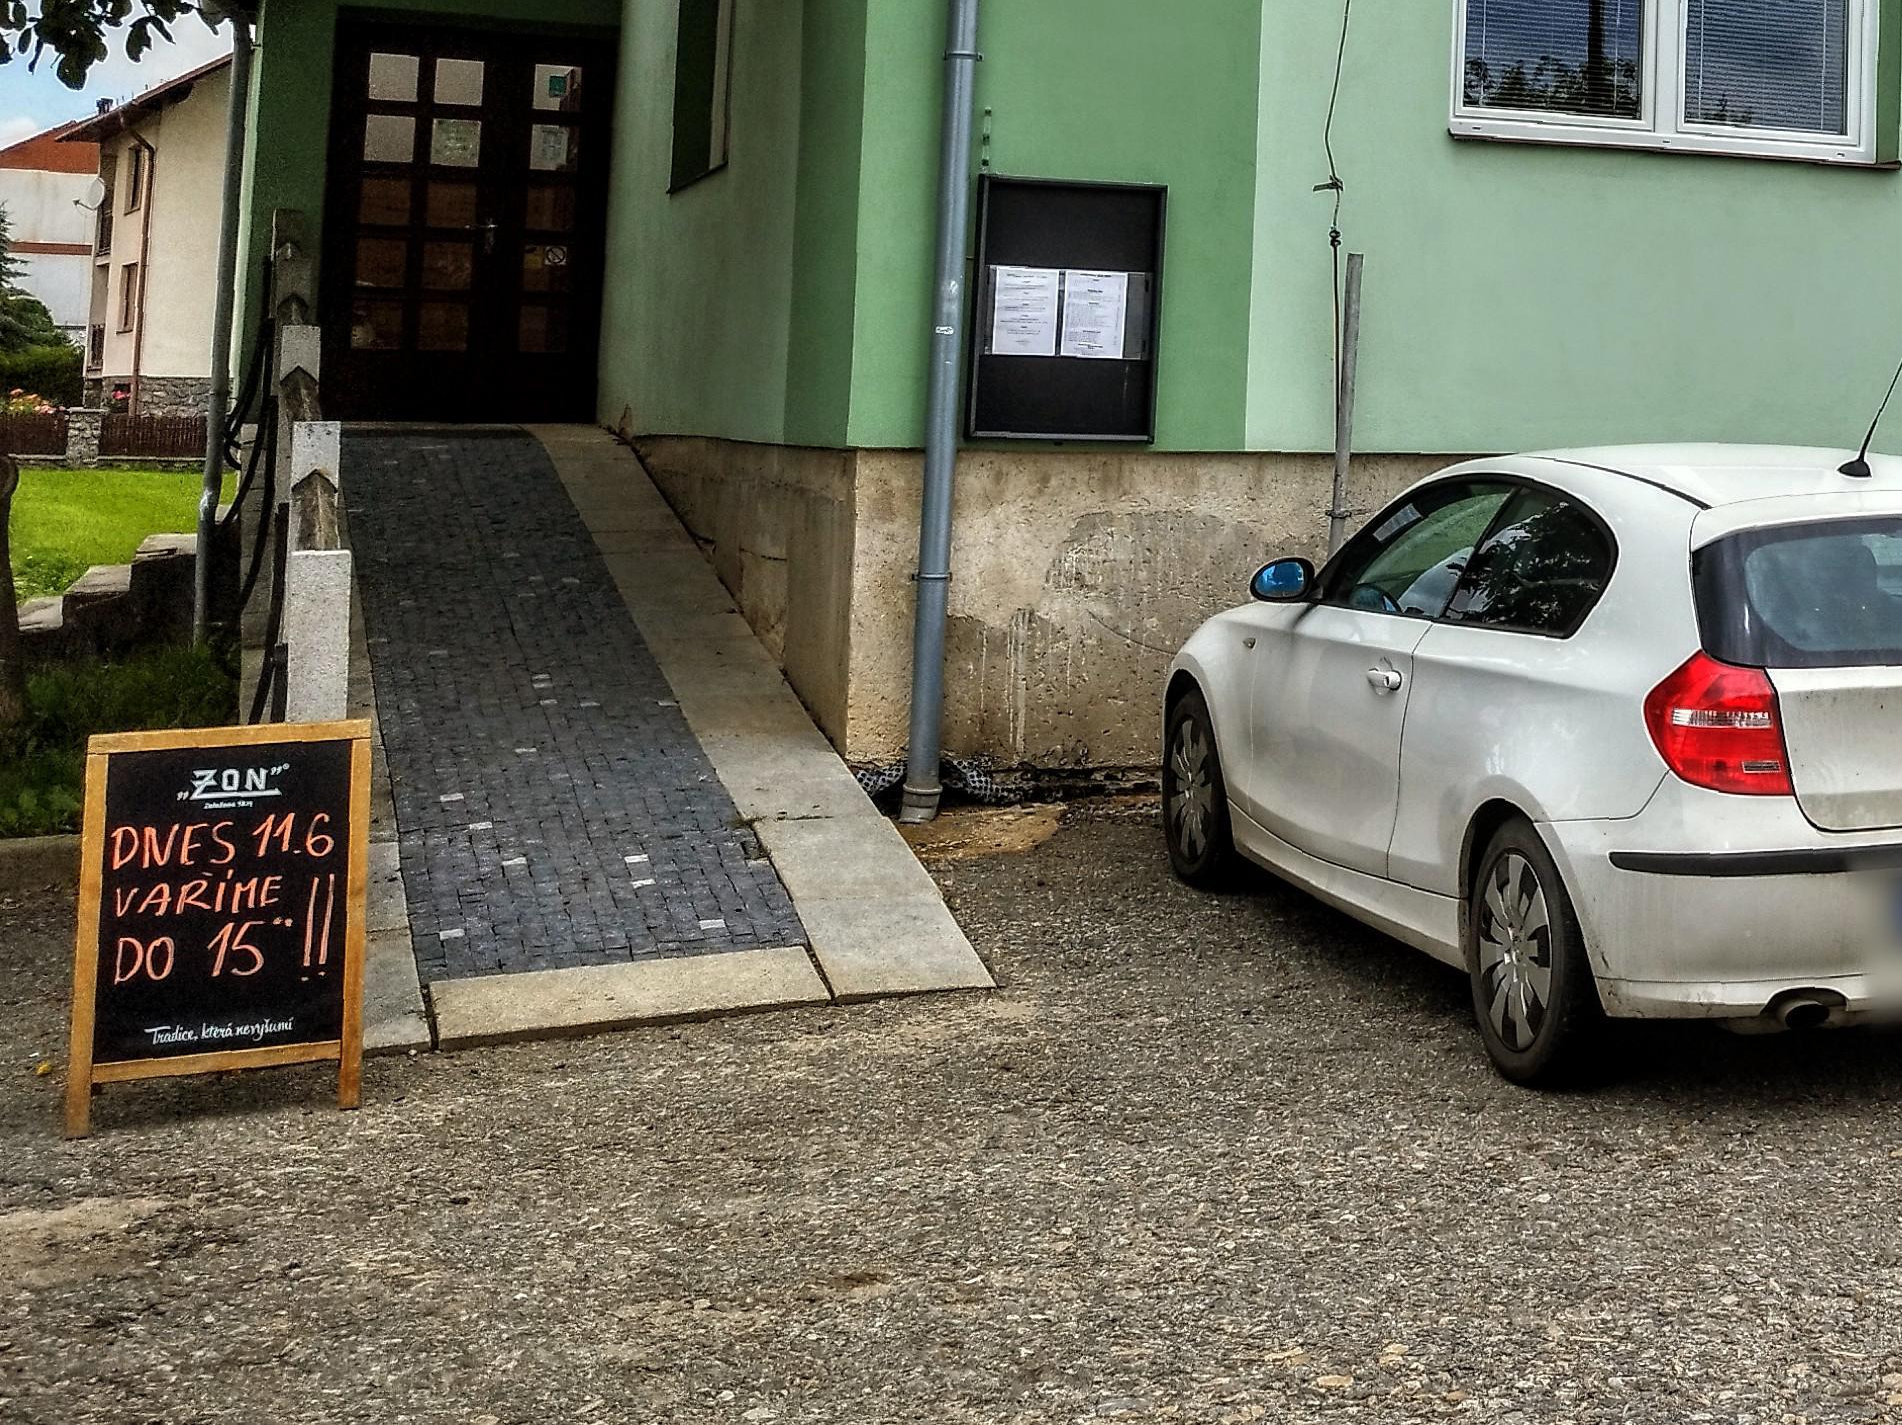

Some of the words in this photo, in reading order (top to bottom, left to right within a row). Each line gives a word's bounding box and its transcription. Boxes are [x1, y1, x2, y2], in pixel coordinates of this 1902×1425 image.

[111, 821, 236, 871] DNES
[115, 868, 283, 918] VAŘÍME
[114, 936, 175, 986] DO
[144, 1025, 199, 1045] Tradice,
[200, 1021, 234, 1040] která
[235, 1016, 295, 1042] nevyšumí
